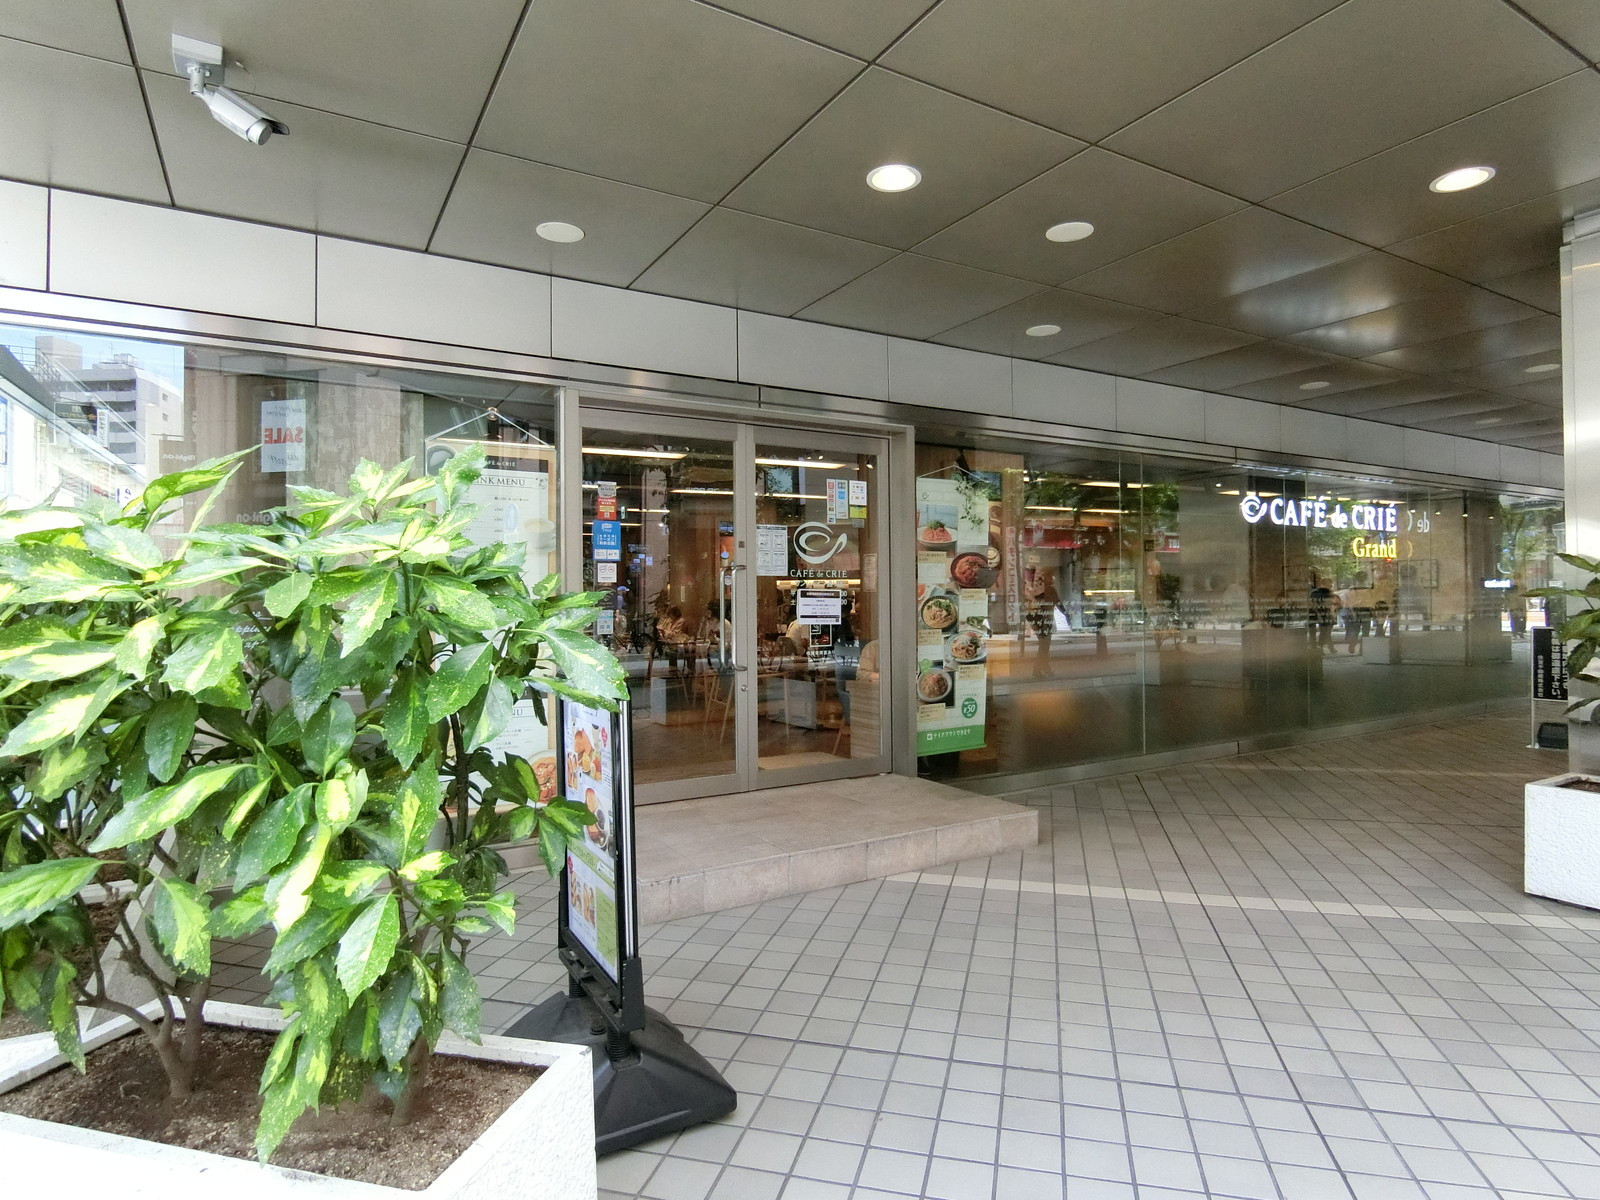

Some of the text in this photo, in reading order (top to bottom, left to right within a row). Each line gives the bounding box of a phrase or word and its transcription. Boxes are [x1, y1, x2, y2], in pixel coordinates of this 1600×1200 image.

[497, 477, 526, 487] MENU
[1269, 495, 1399, 532] CAFÉ de CRIÉ
[1351, 536, 1398, 559] Grand
[789, 567, 815, 578] CAFÉ
[816, 569, 824, 578] de
[932, 728, 972, 740] テイクアウトできます
